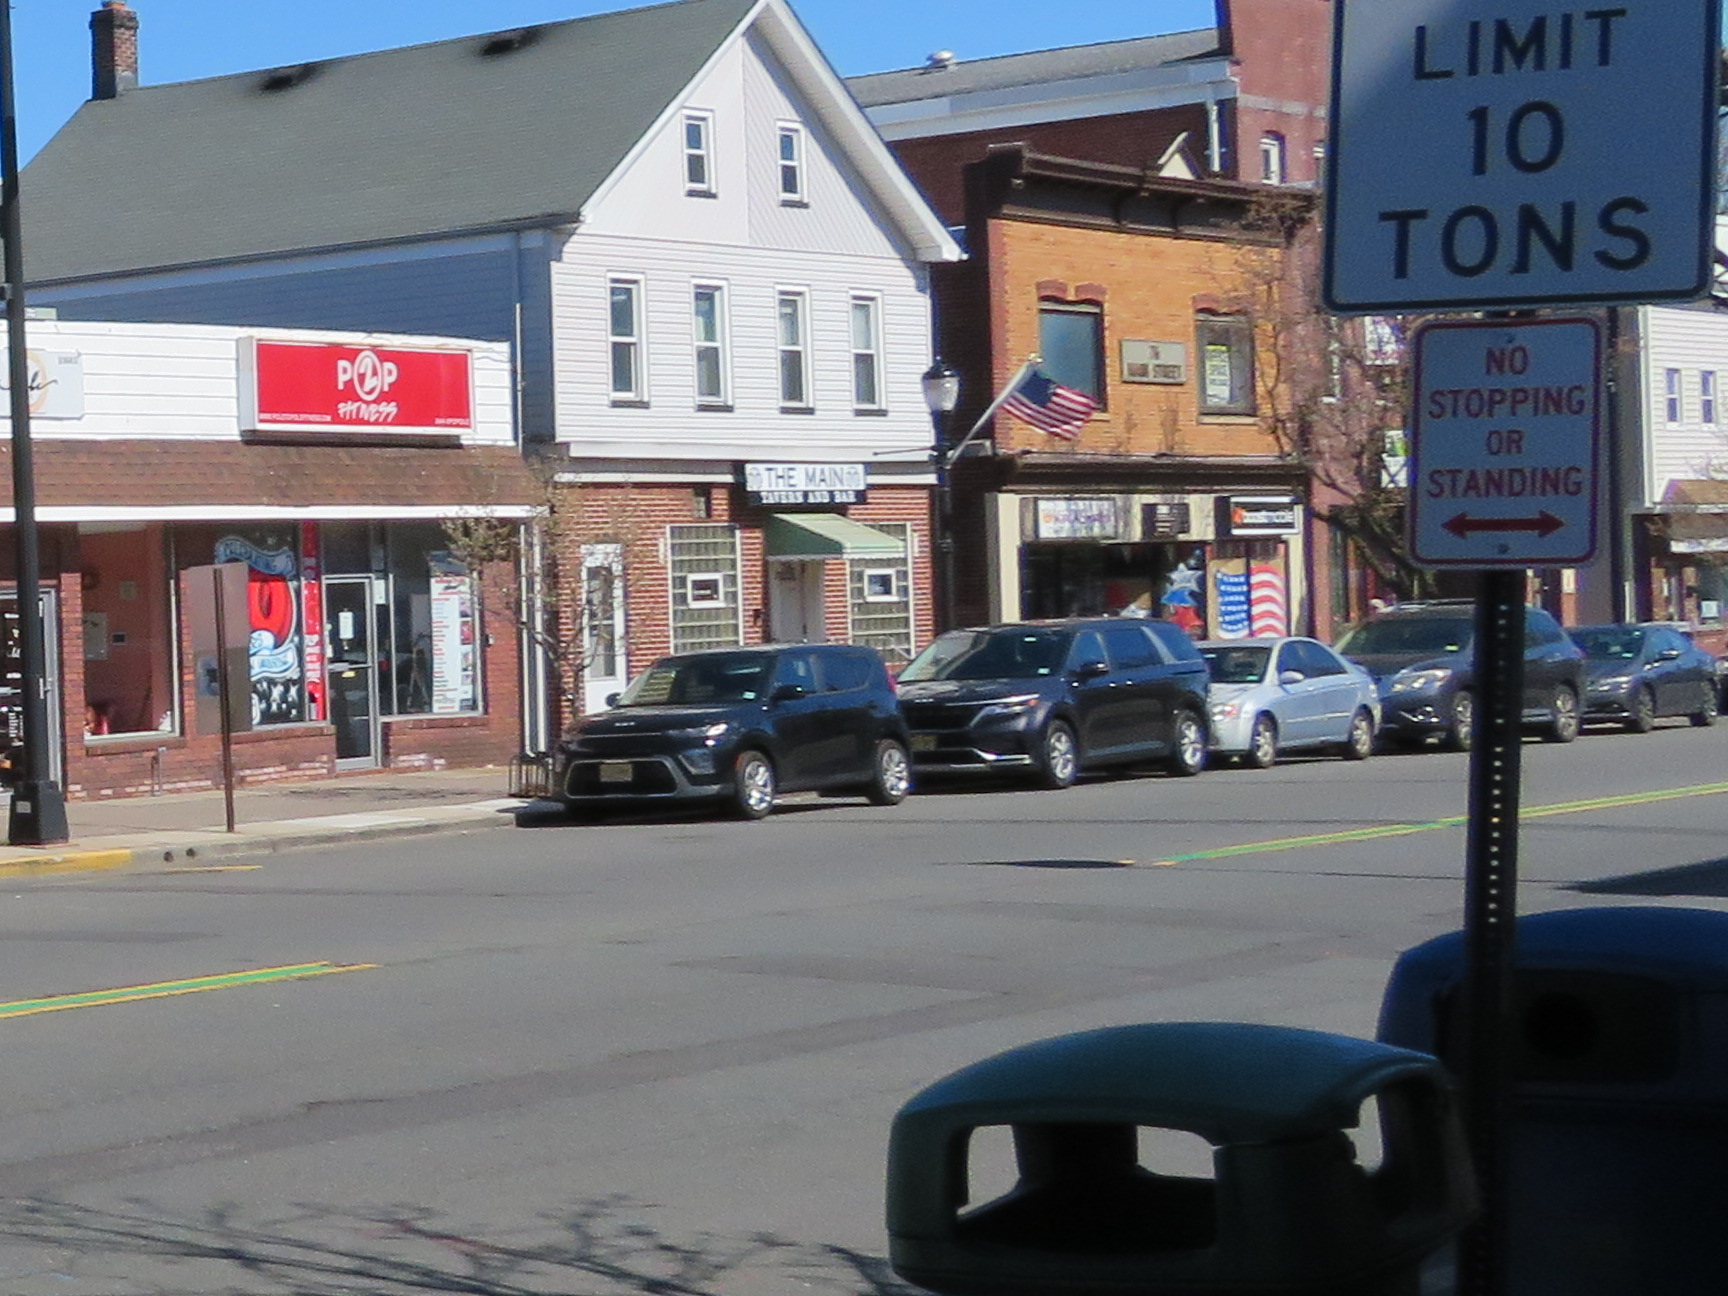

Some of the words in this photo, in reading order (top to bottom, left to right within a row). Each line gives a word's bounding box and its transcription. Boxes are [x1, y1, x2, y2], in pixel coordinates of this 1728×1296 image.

[1414, 8, 1627, 80] LIMIT
[1466, 101, 1564, 176] 10
[1378, 196, 1650, 279] TONS
[1485, 345, 1529, 376] NO
[337, 401, 398, 422] FITNESS
[1428, 385, 1586, 419] STOPPING
[1486, 430, 1525, 455] OR
[764, 467, 796, 488] THE
[804, 467, 844, 488] MAIN
[1427, 466, 1582, 498] STANDING
[760, 491, 803, 503] TAVERN
[807, 491, 830, 503] AND
